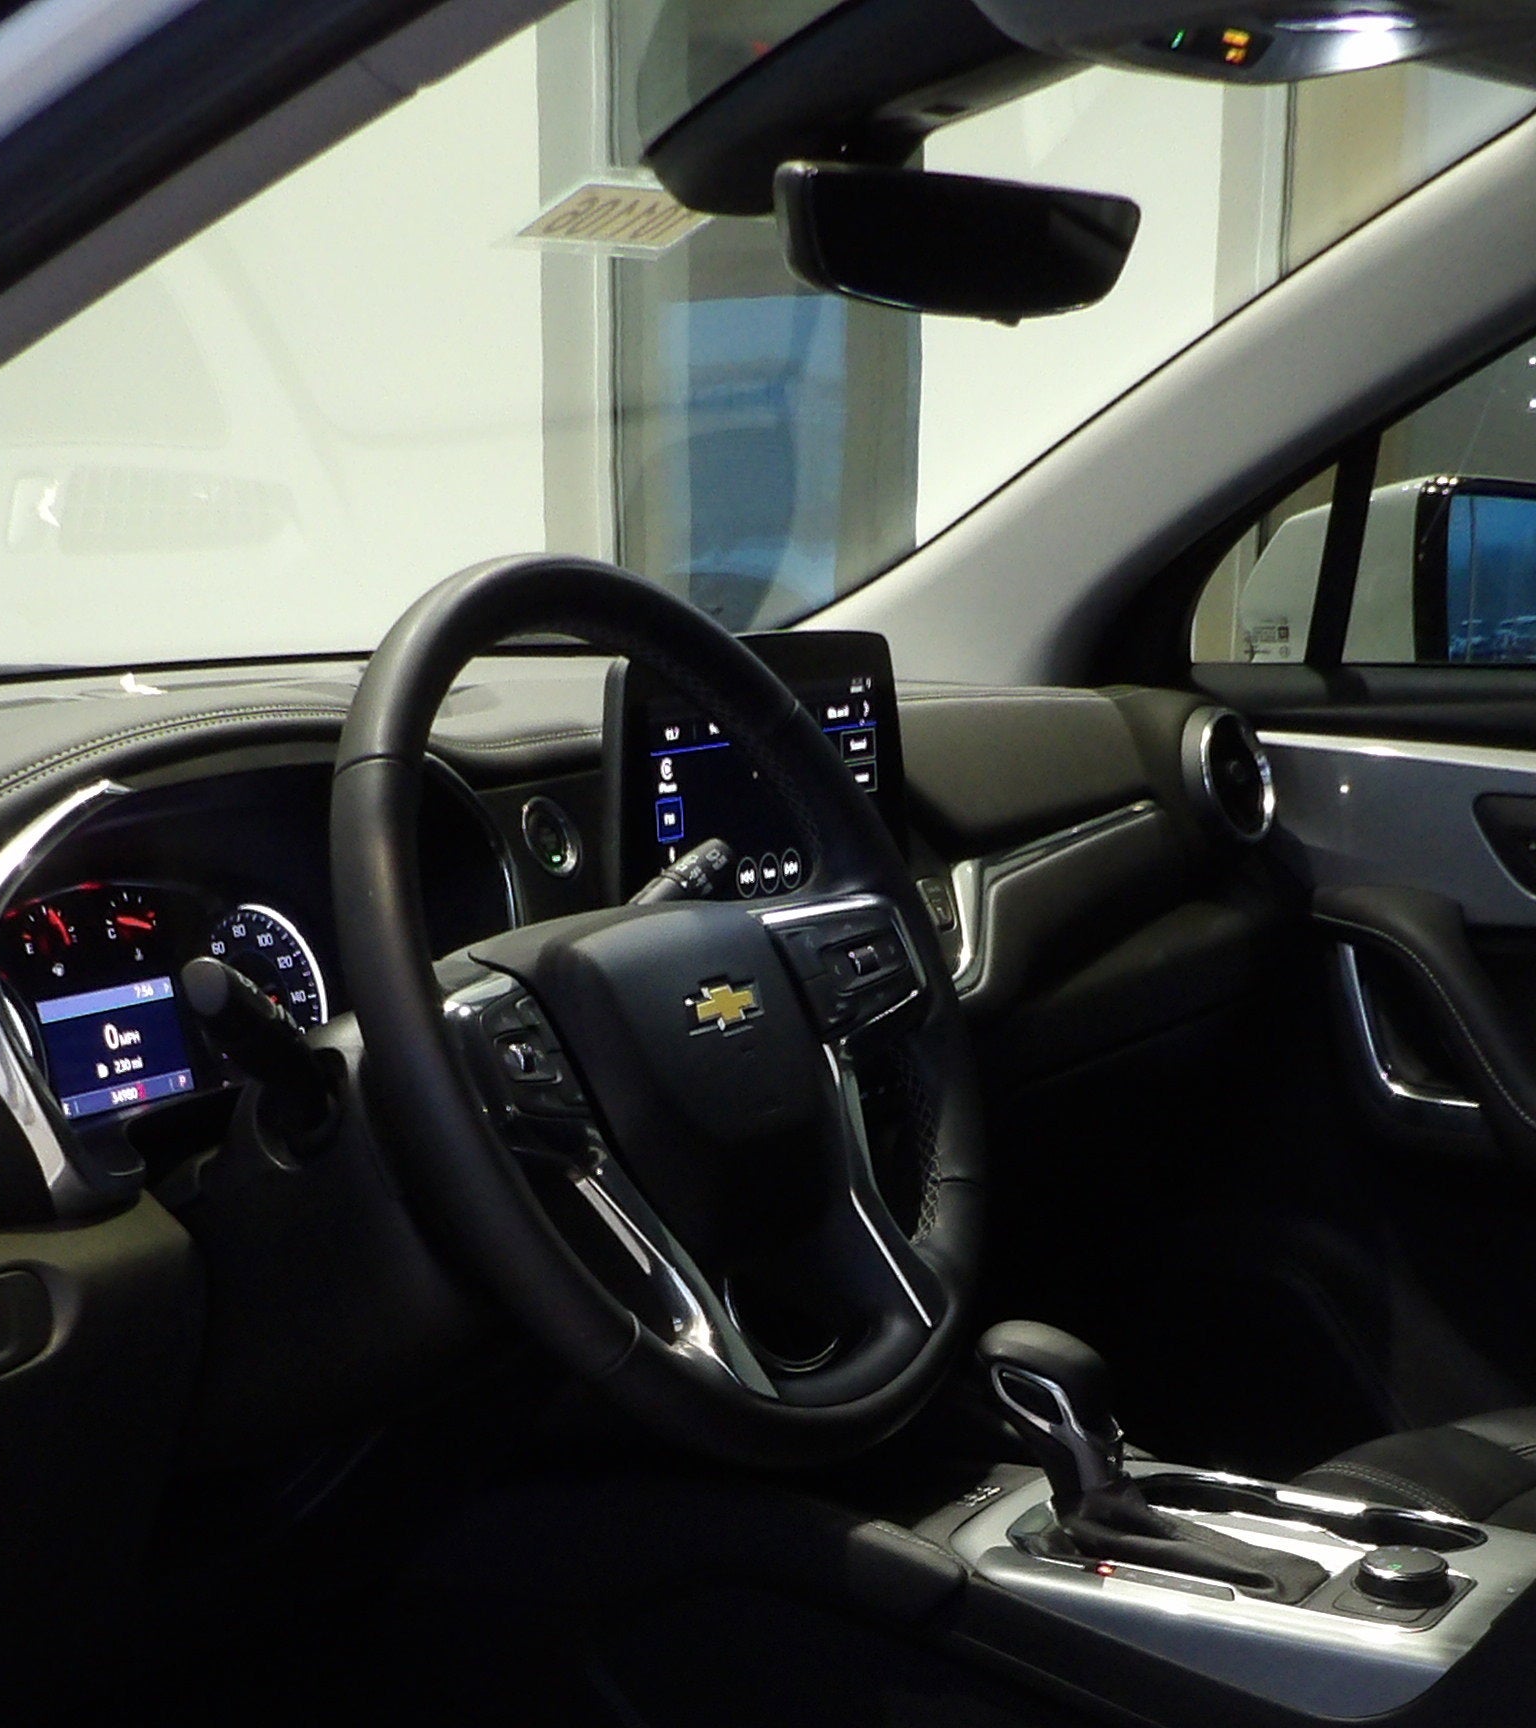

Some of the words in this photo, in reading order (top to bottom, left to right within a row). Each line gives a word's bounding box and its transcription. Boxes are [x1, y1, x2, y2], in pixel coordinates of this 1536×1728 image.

[257, 933, 274, 948] 100
[276, 955, 294, 970] 120
[290, 989, 306, 1003] 140
[103, 1023, 119, 1050] 0
